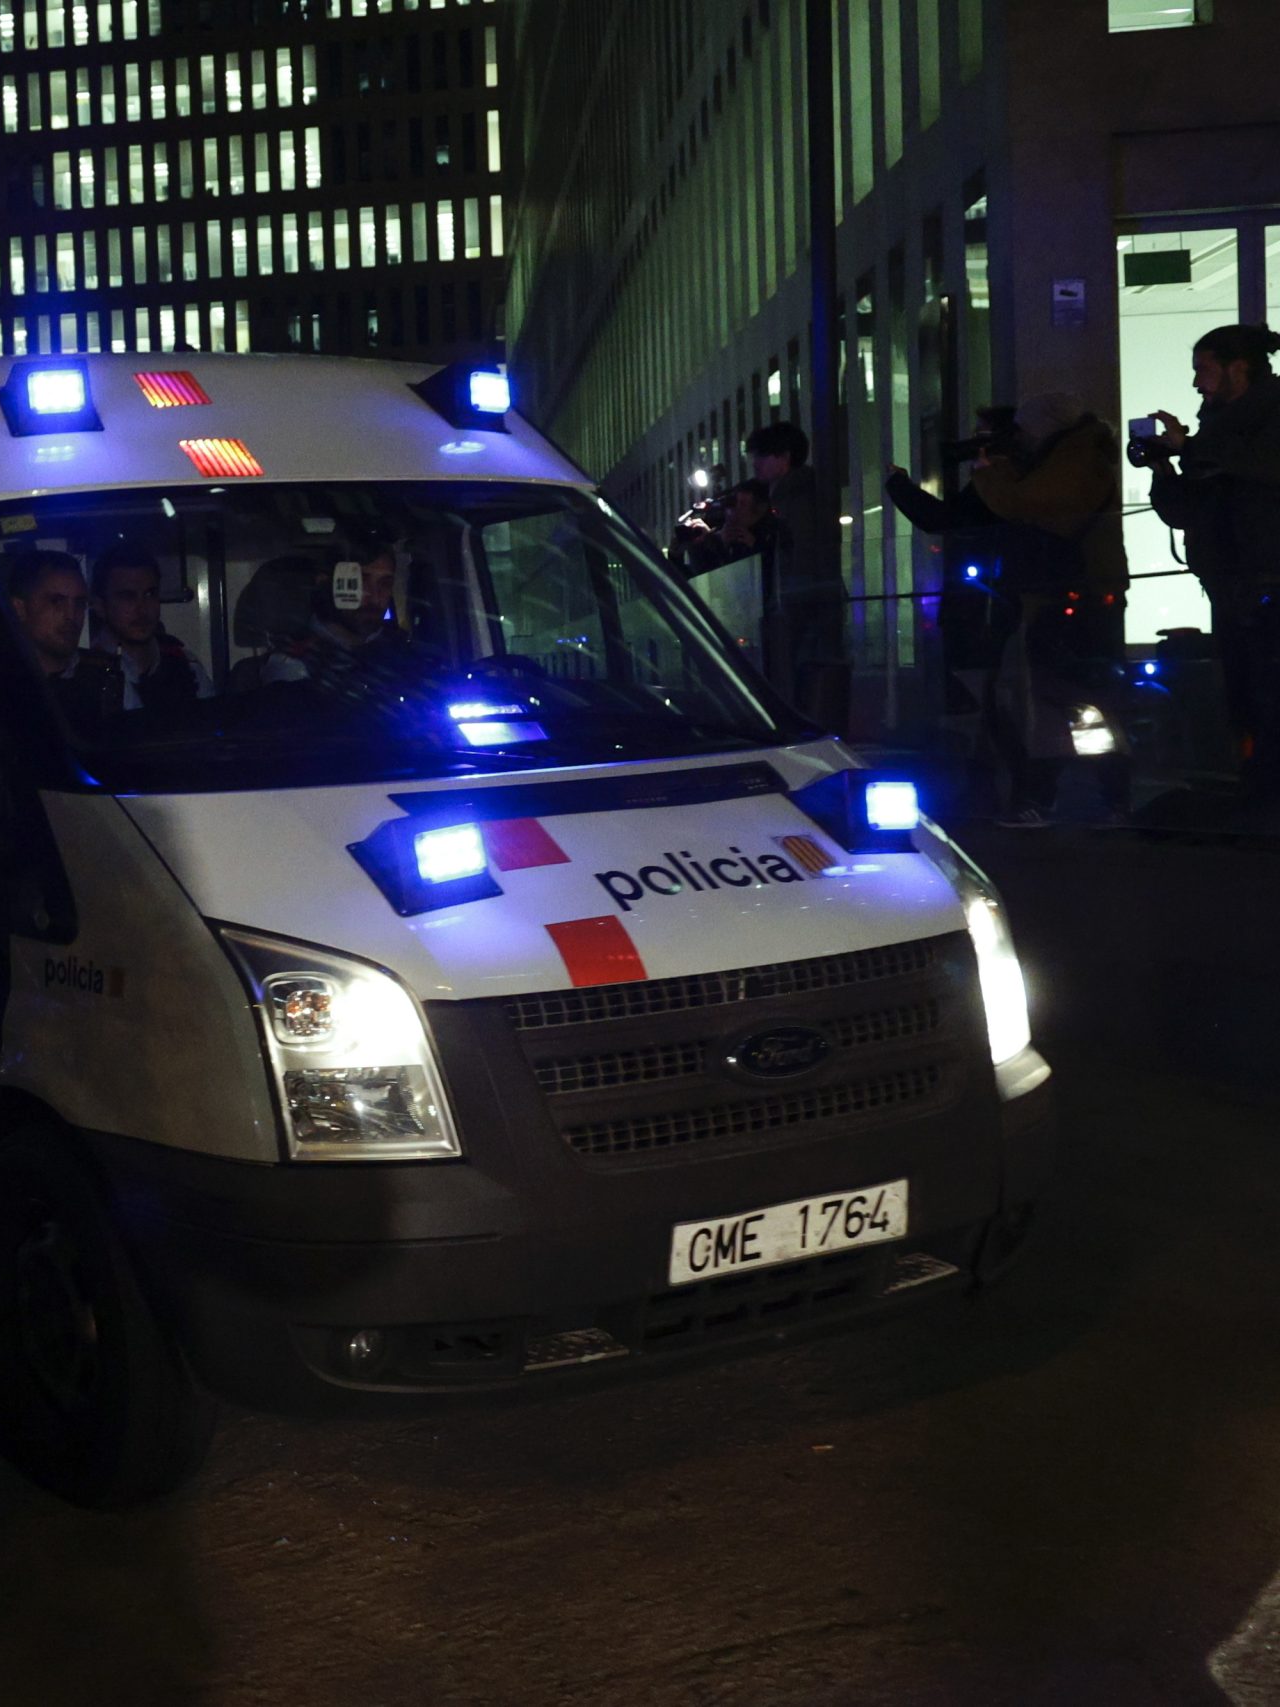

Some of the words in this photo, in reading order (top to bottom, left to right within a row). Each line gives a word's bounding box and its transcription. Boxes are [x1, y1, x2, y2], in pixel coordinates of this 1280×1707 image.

[596, 847, 803, 911] policia
[45, 956, 104, 994] policia
[689, 1214, 764, 1272] CME
[799, 1190, 889, 1248] 1764
